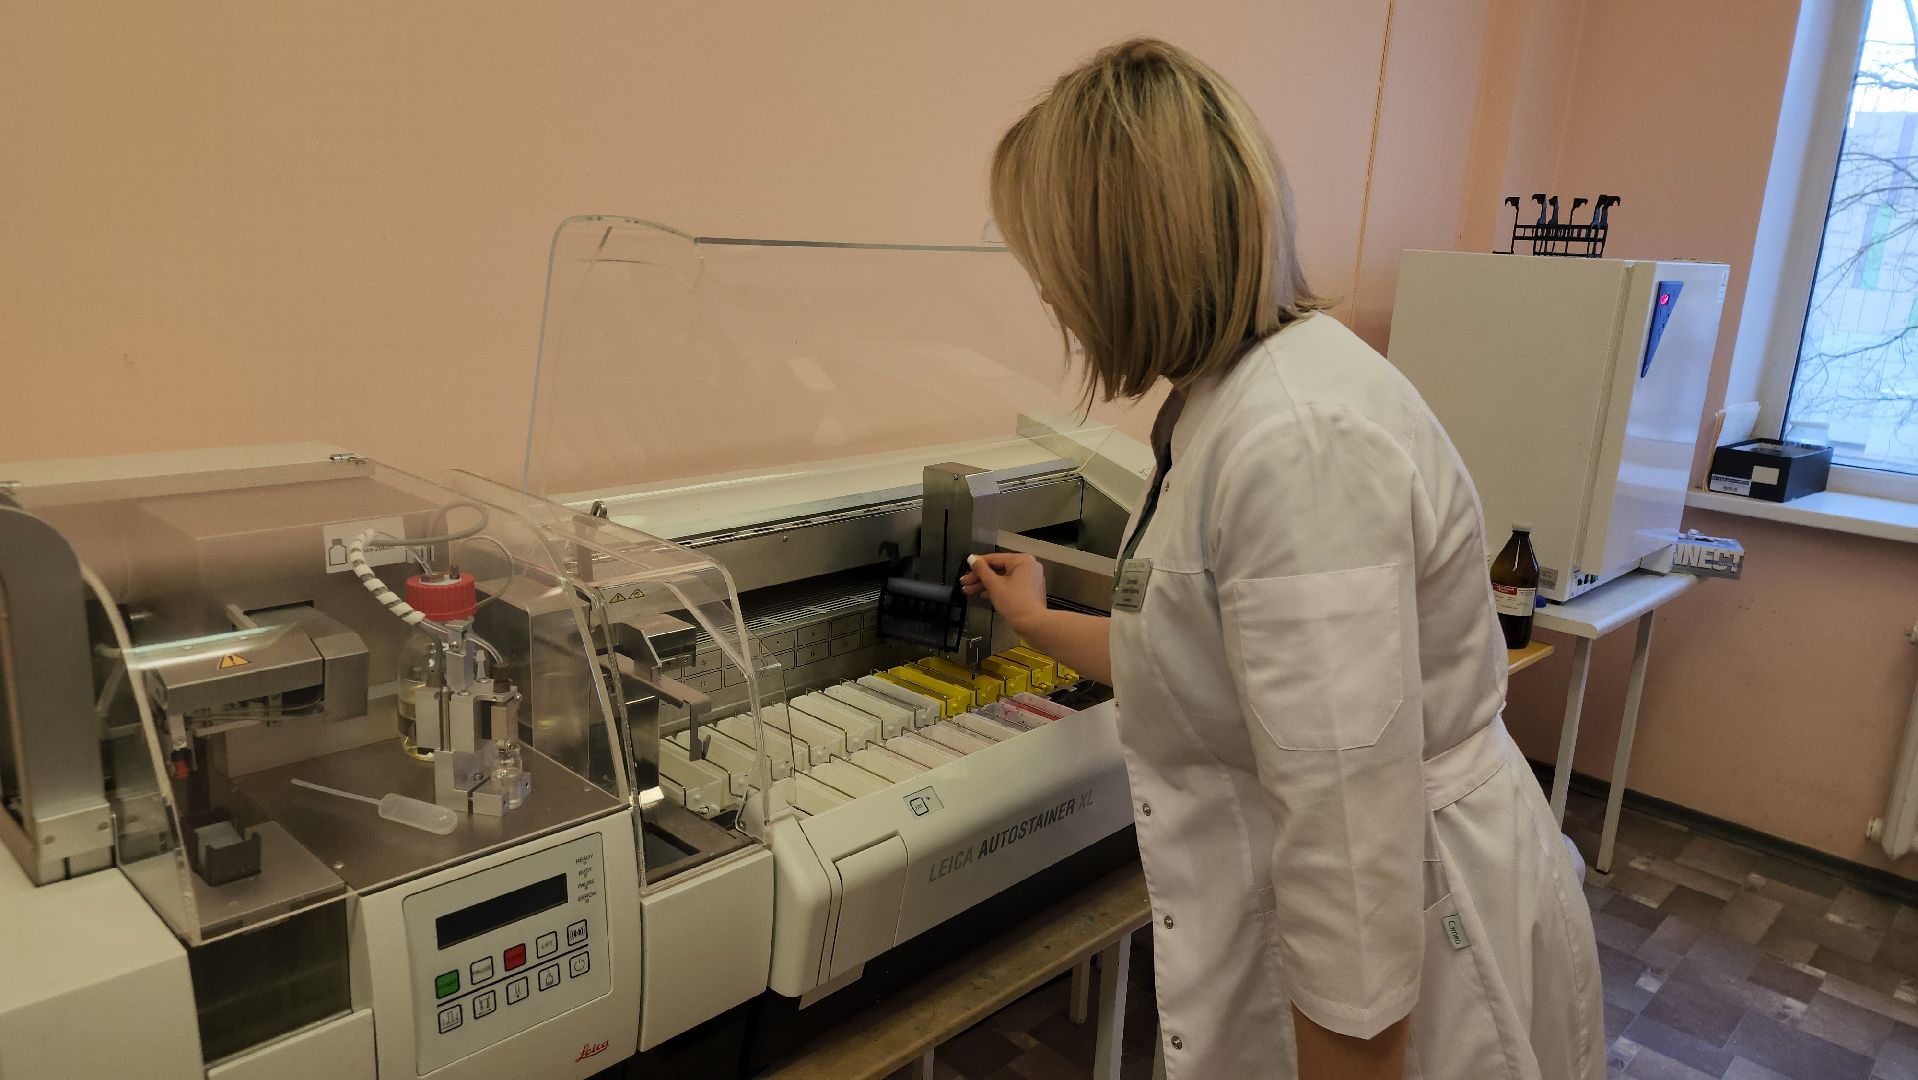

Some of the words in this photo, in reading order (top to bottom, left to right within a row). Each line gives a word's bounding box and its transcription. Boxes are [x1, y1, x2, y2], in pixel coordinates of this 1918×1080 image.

[929, 848, 973, 883] LEICA
[977, 799, 1076, 859] AUTOSTAINER
[1079, 790, 1094, 810] XL
[575, 1040, 609, 1063] Leica
